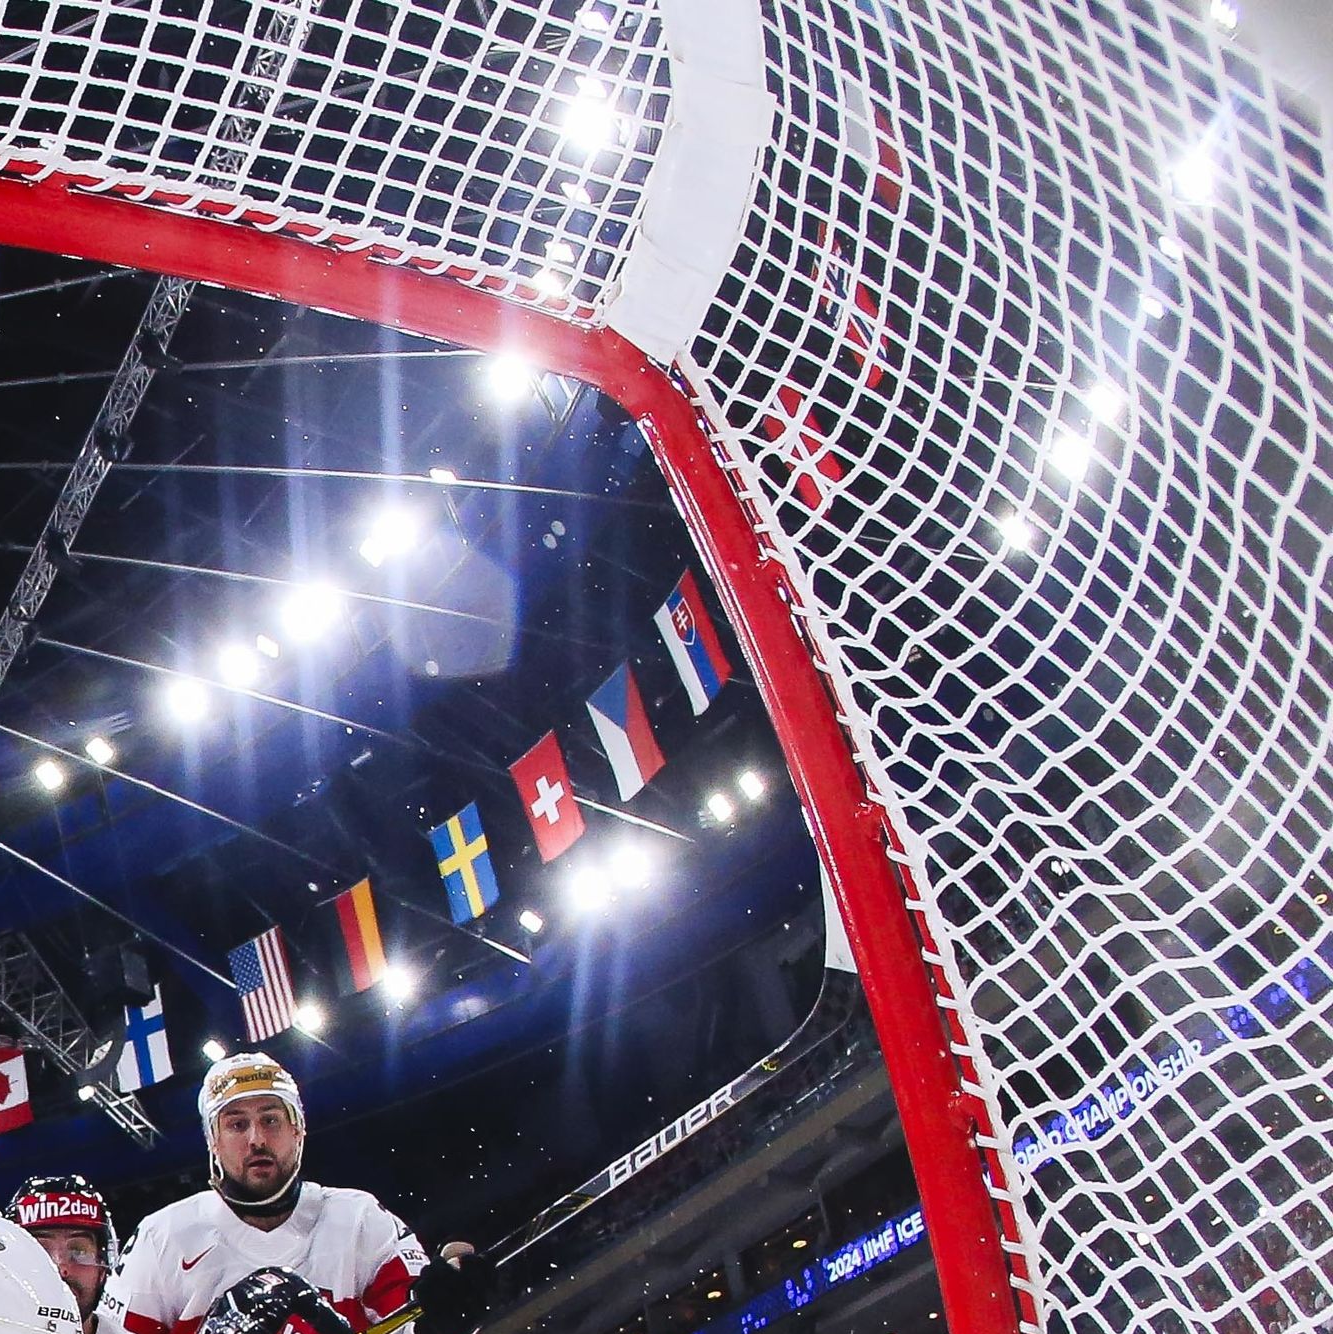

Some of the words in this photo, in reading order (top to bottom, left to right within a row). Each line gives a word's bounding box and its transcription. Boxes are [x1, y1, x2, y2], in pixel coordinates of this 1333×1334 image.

[1064, 1040, 1203, 1138] CHAMPONSHIP
[827, 1248, 862, 1282] 2024
[863, 1228, 894, 1259] IIHF
[896, 1211, 925, 1243] ICE
